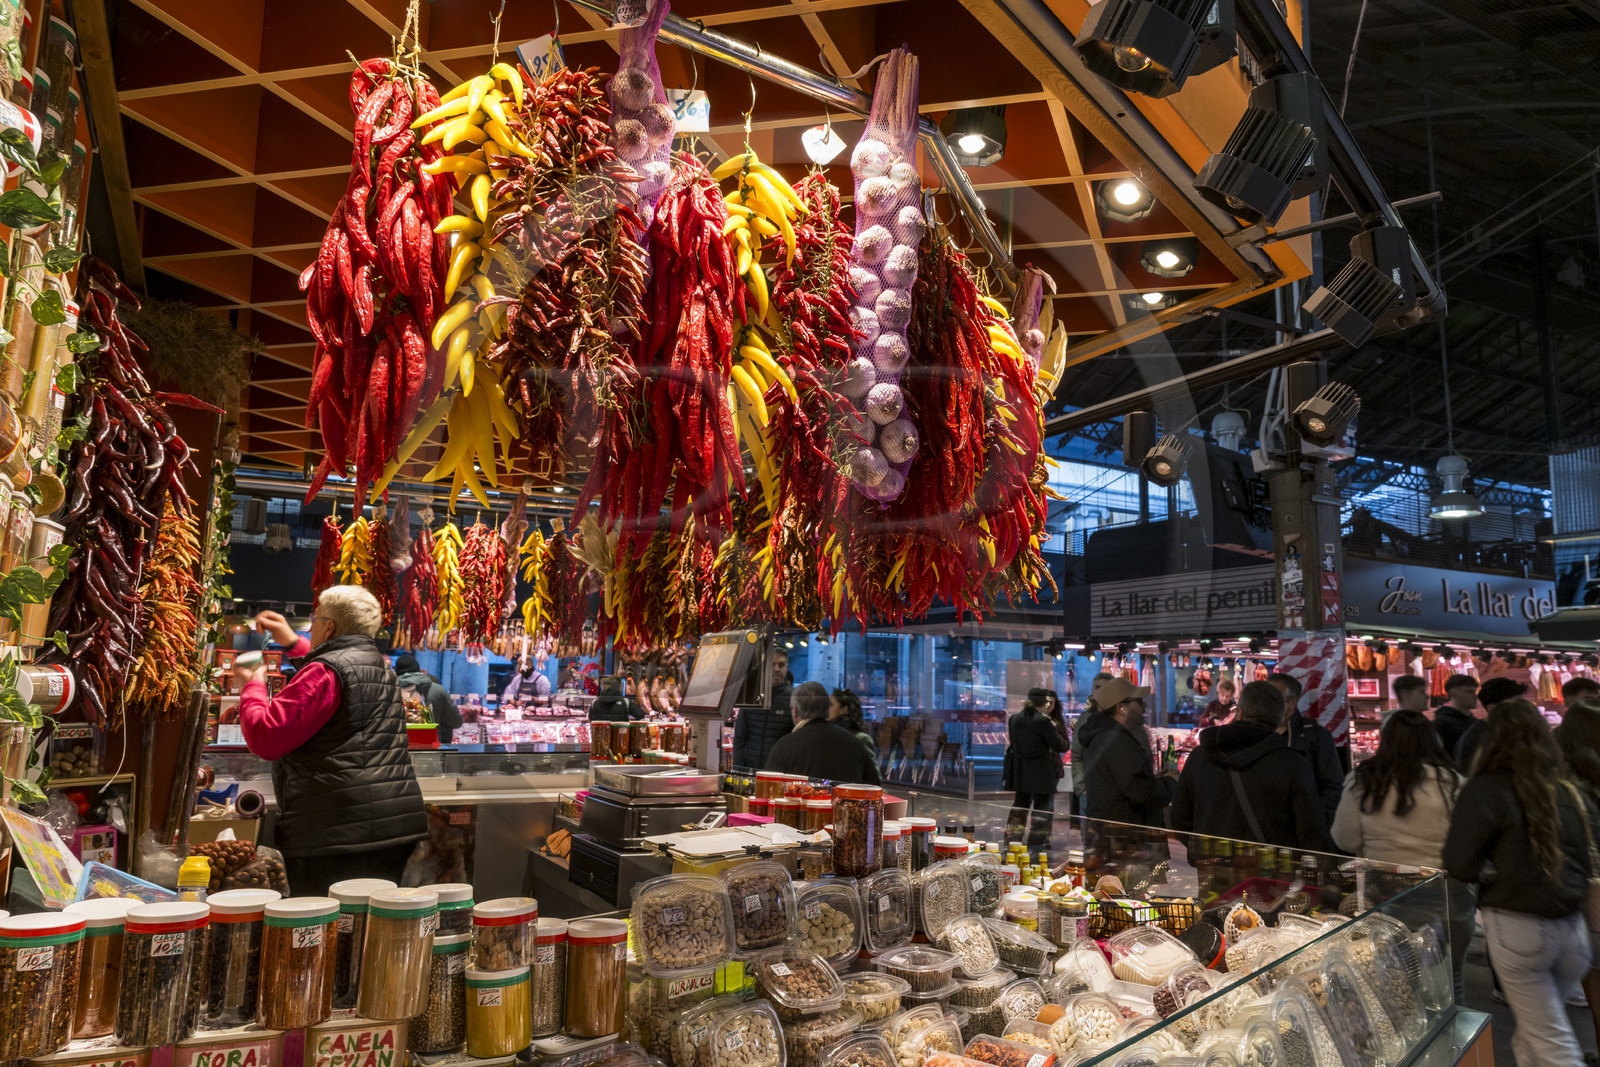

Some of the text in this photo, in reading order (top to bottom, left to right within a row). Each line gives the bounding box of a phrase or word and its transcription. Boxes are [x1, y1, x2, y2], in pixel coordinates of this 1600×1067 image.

[1101, 597, 1123, 617] La
[1129, 593, 1158, 616] llar
[1164, 588, 1198, 613] del
[1206, 578, 1276, 617] pernil
[1380, 576, 1423, 613] Joan
[1442, 578, 1557, 620] La llar del
[153, 933, 183, 942] CLAVO
[196, 1048, 257, 1067] ÑORA
[318, 1029, 394, 1055] CANELA
